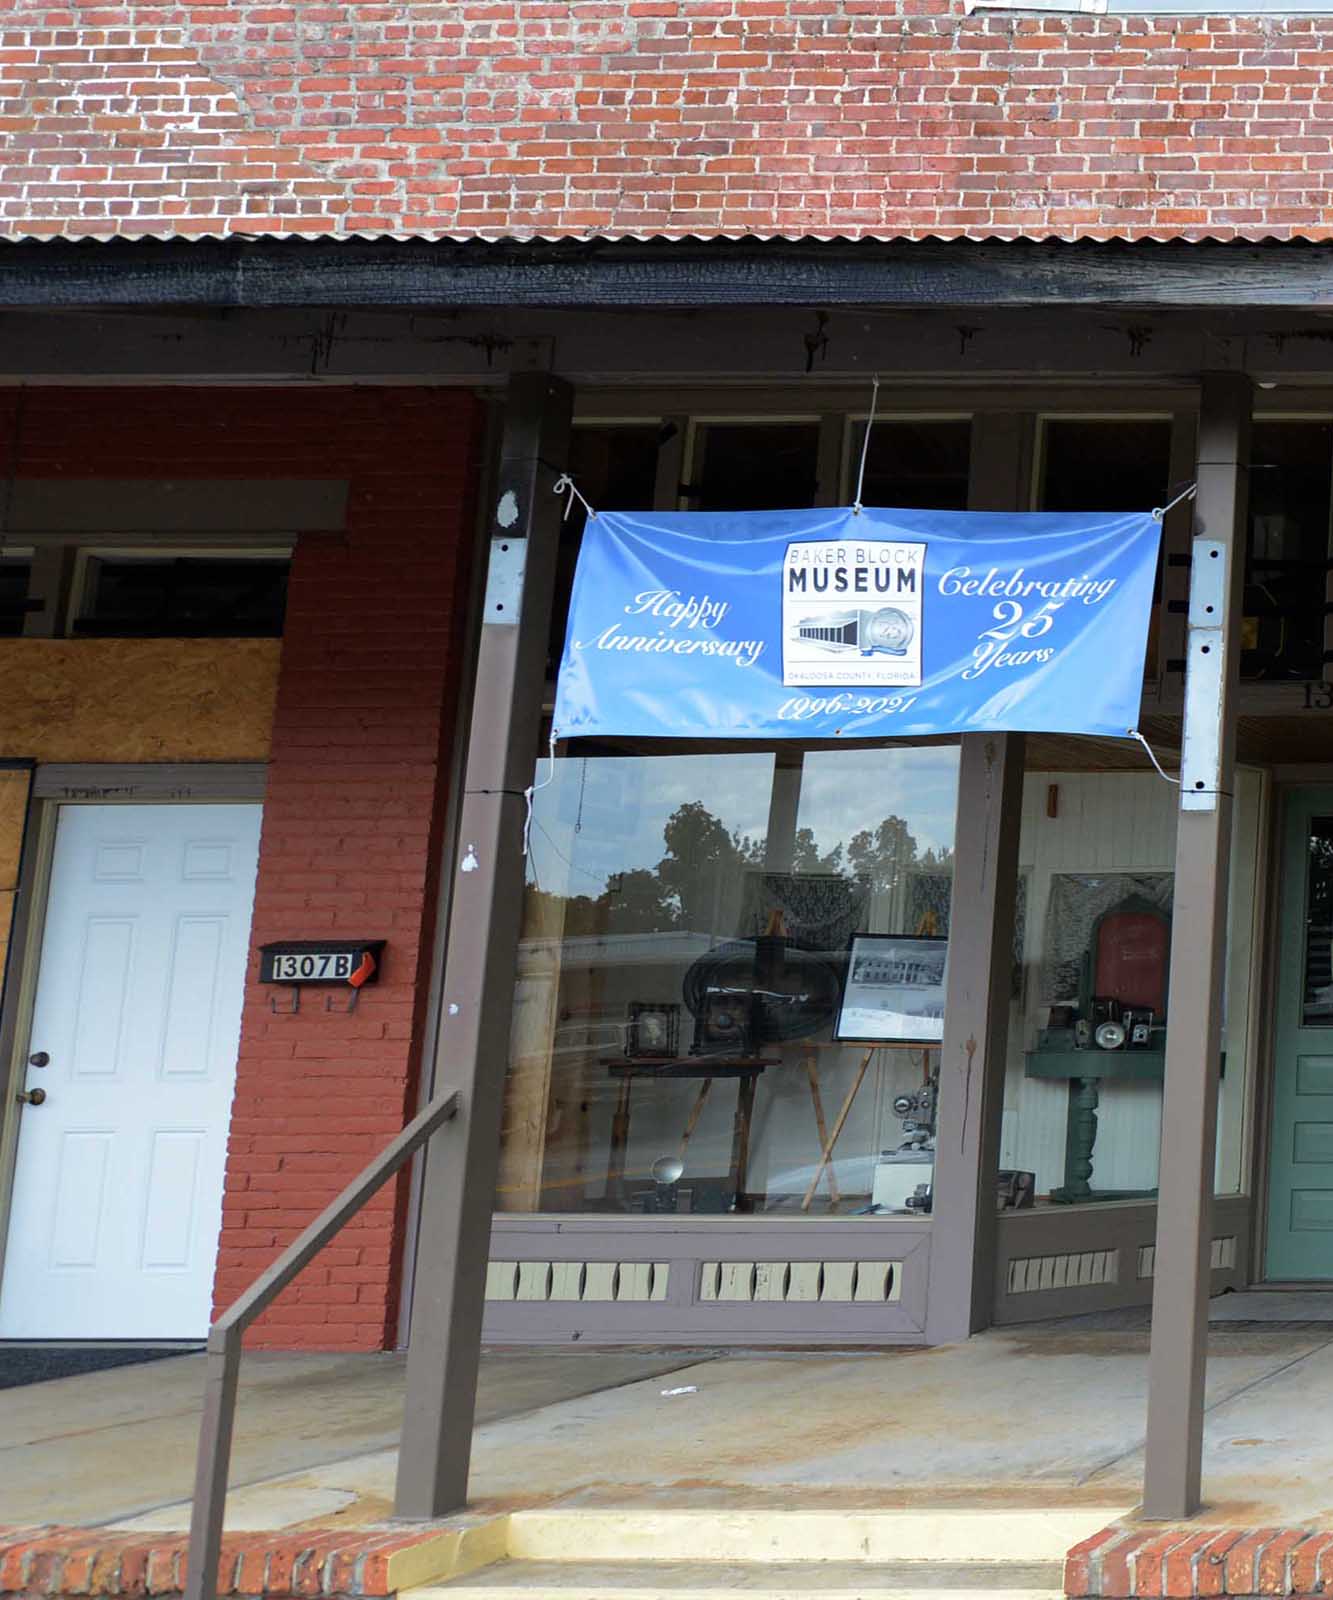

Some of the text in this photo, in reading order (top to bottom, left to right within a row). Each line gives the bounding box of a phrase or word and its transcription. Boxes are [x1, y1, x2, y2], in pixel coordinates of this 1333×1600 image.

[789, 548, 918, 564] BAKER BLOCK
[789, 567, 915, 592] MUSEUM
[938, 566, 1117, 605] Celebrating
[624, 590, 729, 629] Happy
[978, 600, 1064, 640] 25
[575, 623, 764, 667] Anniversary
[962, 642, 1054, 680] Years
[777, 692, 918, 721] 1996-2021
[275, 956, 349, 977] 1307B
